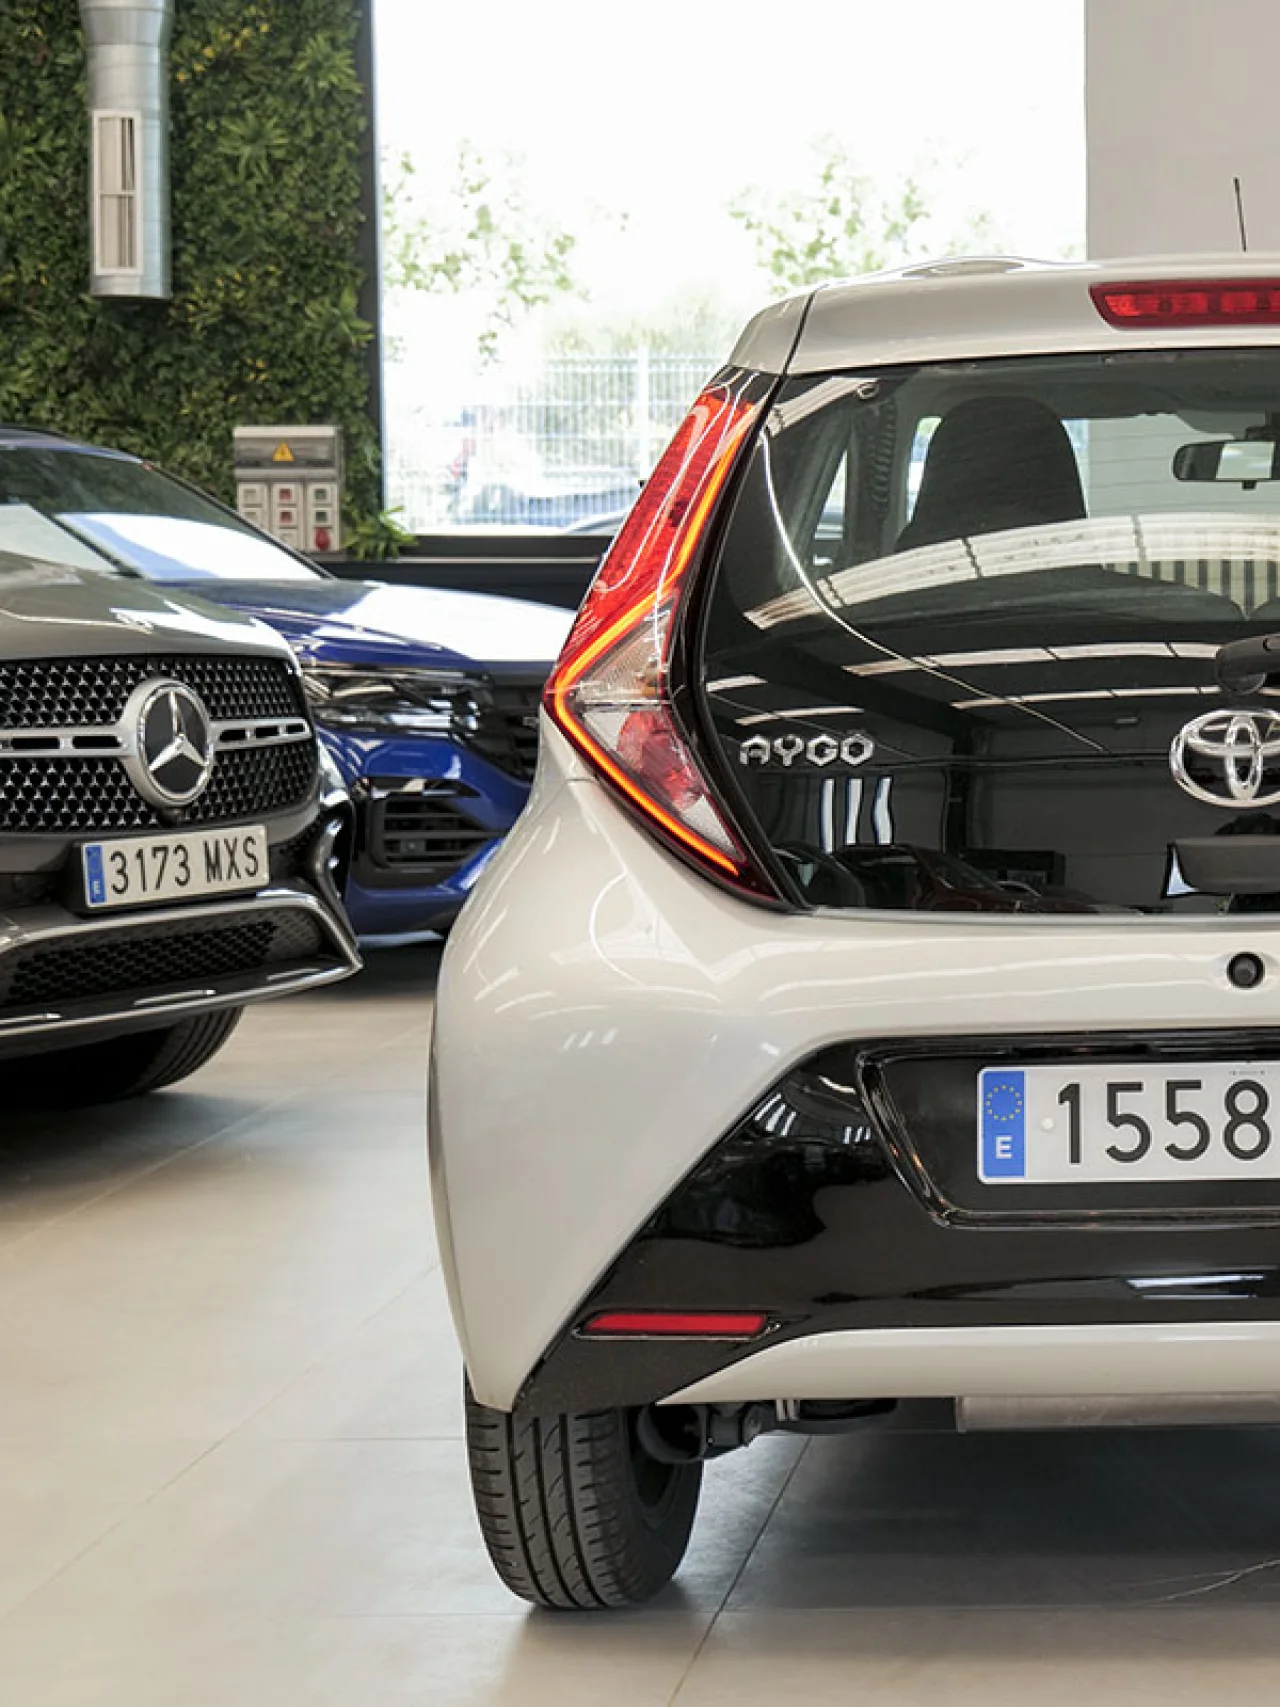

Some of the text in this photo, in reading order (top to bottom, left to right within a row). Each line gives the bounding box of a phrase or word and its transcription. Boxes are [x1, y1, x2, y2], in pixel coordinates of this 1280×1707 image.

[739, 733, 874, 766] AYGO
[109, 836, 258, 894] 3173 MXS
[93, 880, 101, 895] E
[1057, 1079, 1271, 1164] 1558
[994, 1136, 1013, 1160] E
